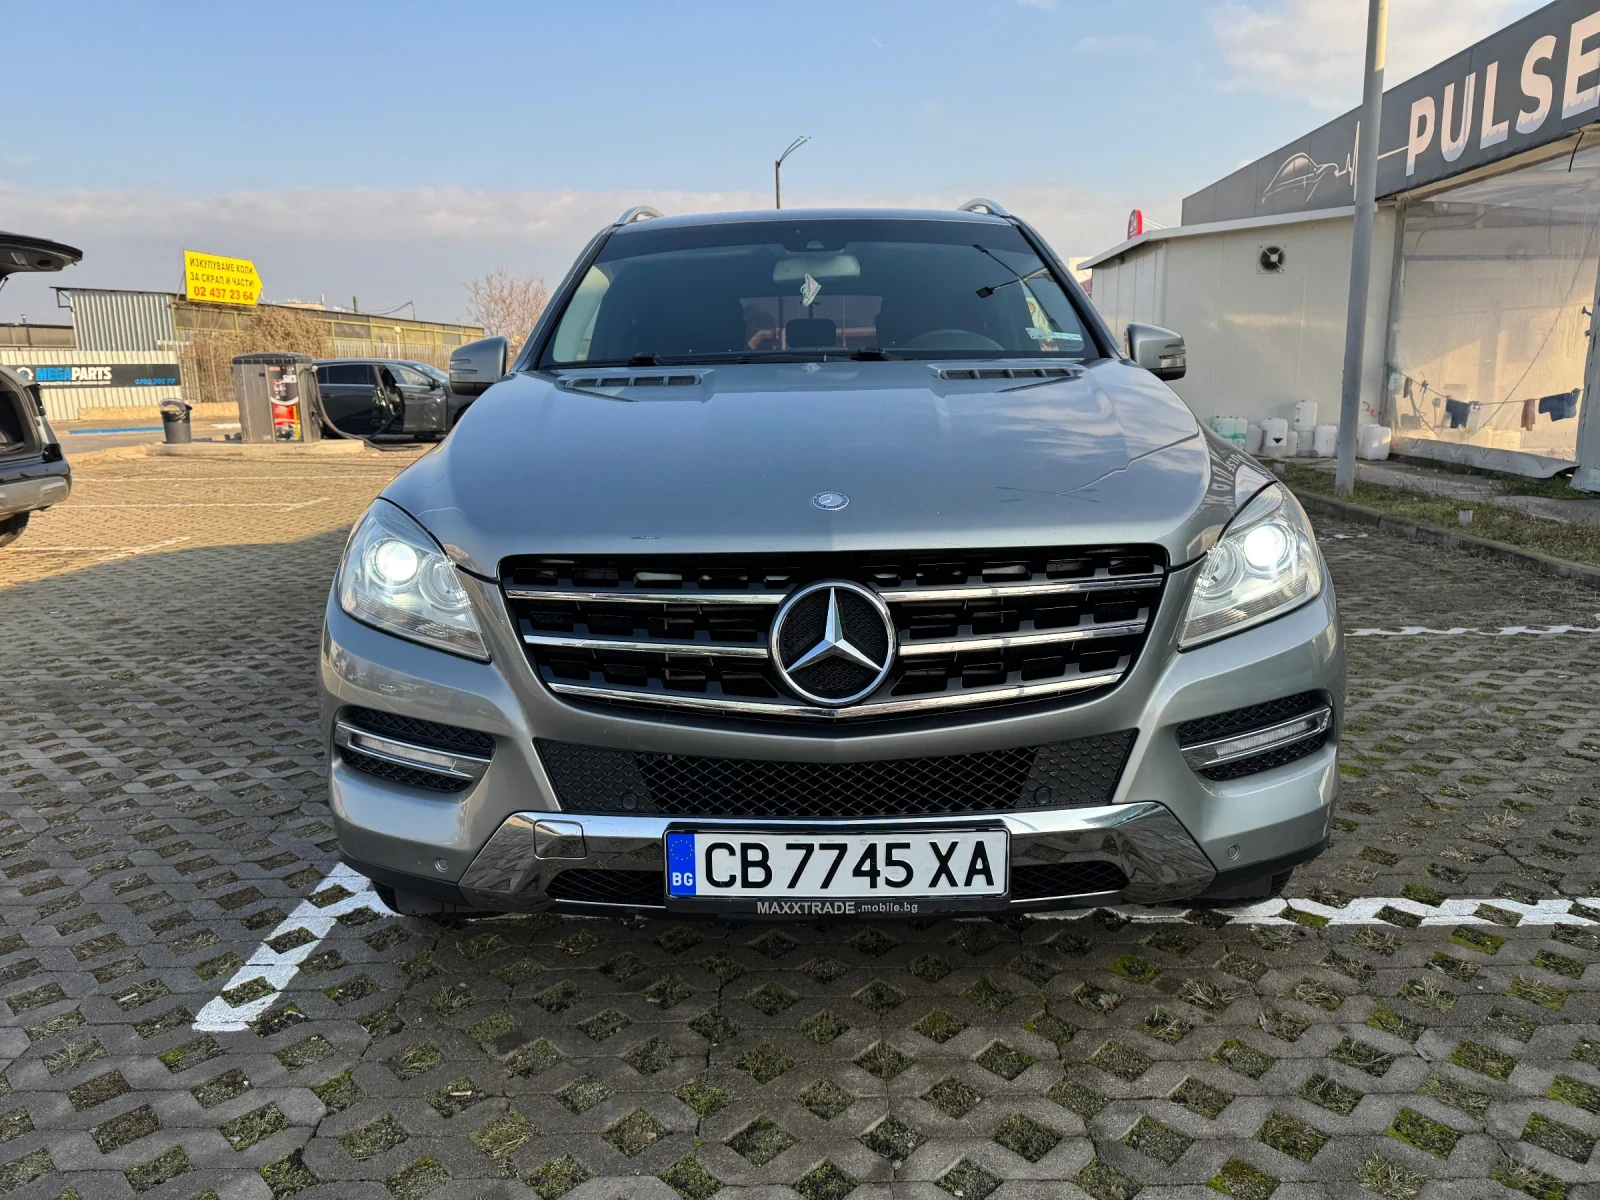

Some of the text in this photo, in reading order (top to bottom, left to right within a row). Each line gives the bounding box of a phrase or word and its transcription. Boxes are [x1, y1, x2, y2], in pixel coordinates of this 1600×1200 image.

[1405, 11, 1600, 176] PULSE
[189, 257, 254, 275] ИЗКУПУВАМЕ КОЛИ
[190, 271, 200, 281] ЗА
[201, 273, 225, 285] СКРАП
[226, 276, 231, 286] И
[193, 286, 254, 301] 02 437 23 64
[35, 367, 112, 381] MEGAPARTS
[704, 840, 995, 889] CB 7745 XA
[672, 872, 694, 887] BG
[757, 901, 856, 915] MAXXTRADE
